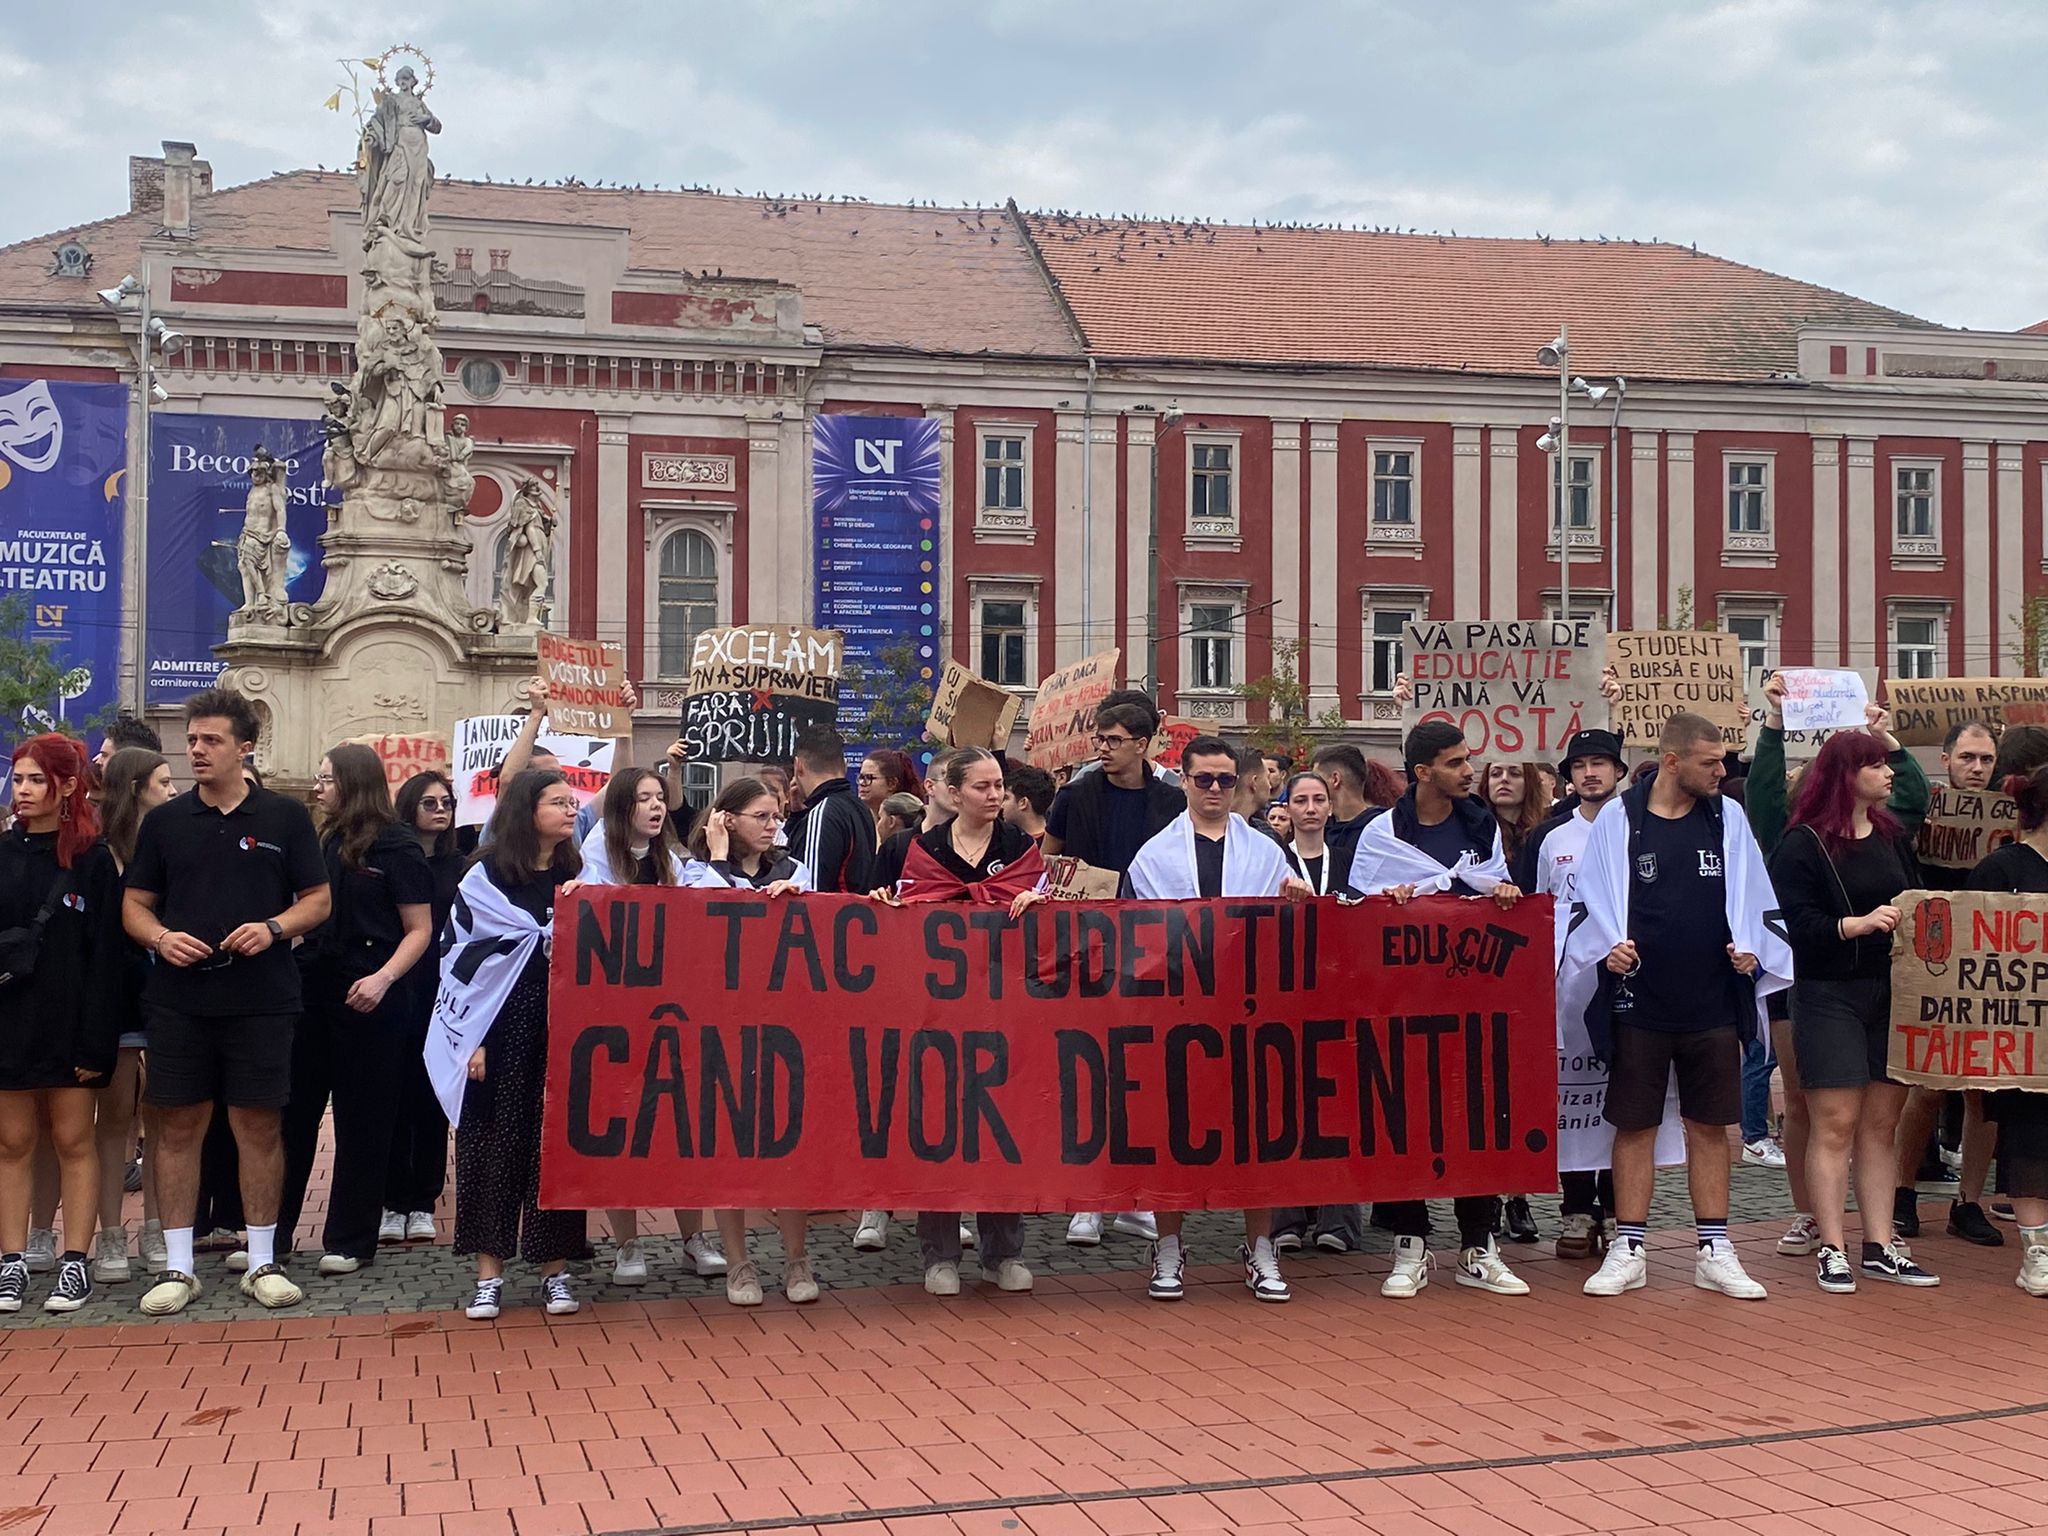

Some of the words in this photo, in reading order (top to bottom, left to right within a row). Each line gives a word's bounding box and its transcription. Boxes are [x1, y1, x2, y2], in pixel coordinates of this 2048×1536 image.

[168, 444, 300, 477] Becoe
[18, 530, 73, 540] FACULTATEA
[74, 532, 87, 541] DE
[0, 540, 106, 566] MUZICĂ
[3, 567, 106, 592] TEATRU
[1410, 622, 1453, 650] VĂ
[1466, 622, 1538, 648] PASĂ
[1551, 622, 1590, 648] DE
[1617, 636, 1724, 658] STUDENT
[151, 661, 220, 673] ADMITERE
[548, 661, 606, 687] VOSTRU
[1630, 659, 1683, 679] BURSĂ
[1690, 662, 1700, 677] E
[1707, 663, 1734, 680] UN
[150, 678, 217, 688] admitere.uvt
[1414, 681, 1491, 708] PÂNĂ
[1512, 679, 1546, 705] VĂ
[1674, 683, 1700, 701] CU
[1707, 684, 1734, 703] UN
[553, 707, 612, 730] NOSTRU
[688, 692, 744, 722] FĂRĂ
[1895, 707, 1939, 732] DAR
[576, 900, 666, 988] NU
[707, 901, 878, 993] TAC
[923, 902, 1317, 1016] STUDENȚII
[1920, 996, 1972, 1024] DAR
[1895, 1024, 2034, 1077] TĂIERI
[567, 1002, 805, 1160] CÂND
[849, 1027, 1022, 1164] VOR
[1055, 1011, 1548, 1180] DECIDENȚII.
